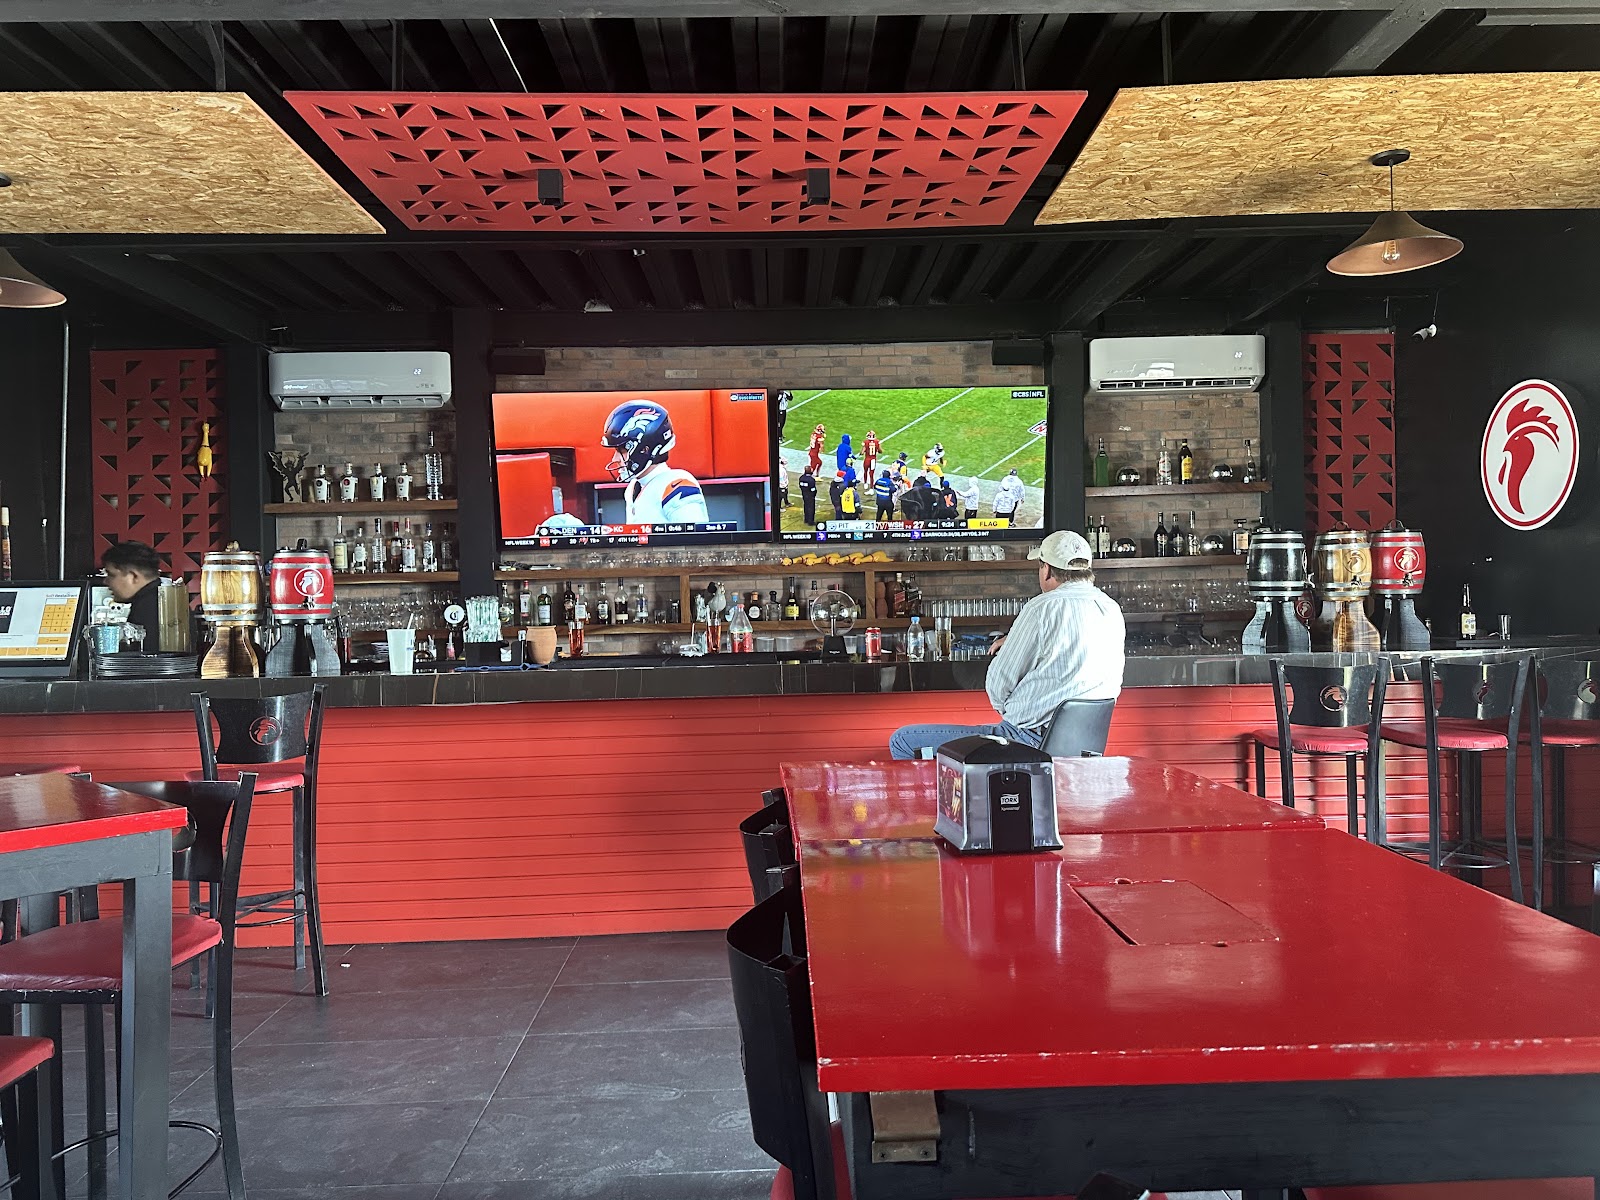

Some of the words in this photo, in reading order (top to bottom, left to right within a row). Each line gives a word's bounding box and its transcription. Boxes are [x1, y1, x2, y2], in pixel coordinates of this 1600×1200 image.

[613, 525, 624, 533] KC
[640, 524, 652, 534] 16
[864, 522, 875, 530] 21
[912, 520, 925, 529] 27
[562, 527, 577, 535] DEN
[590, 526, 601, 535] 14
